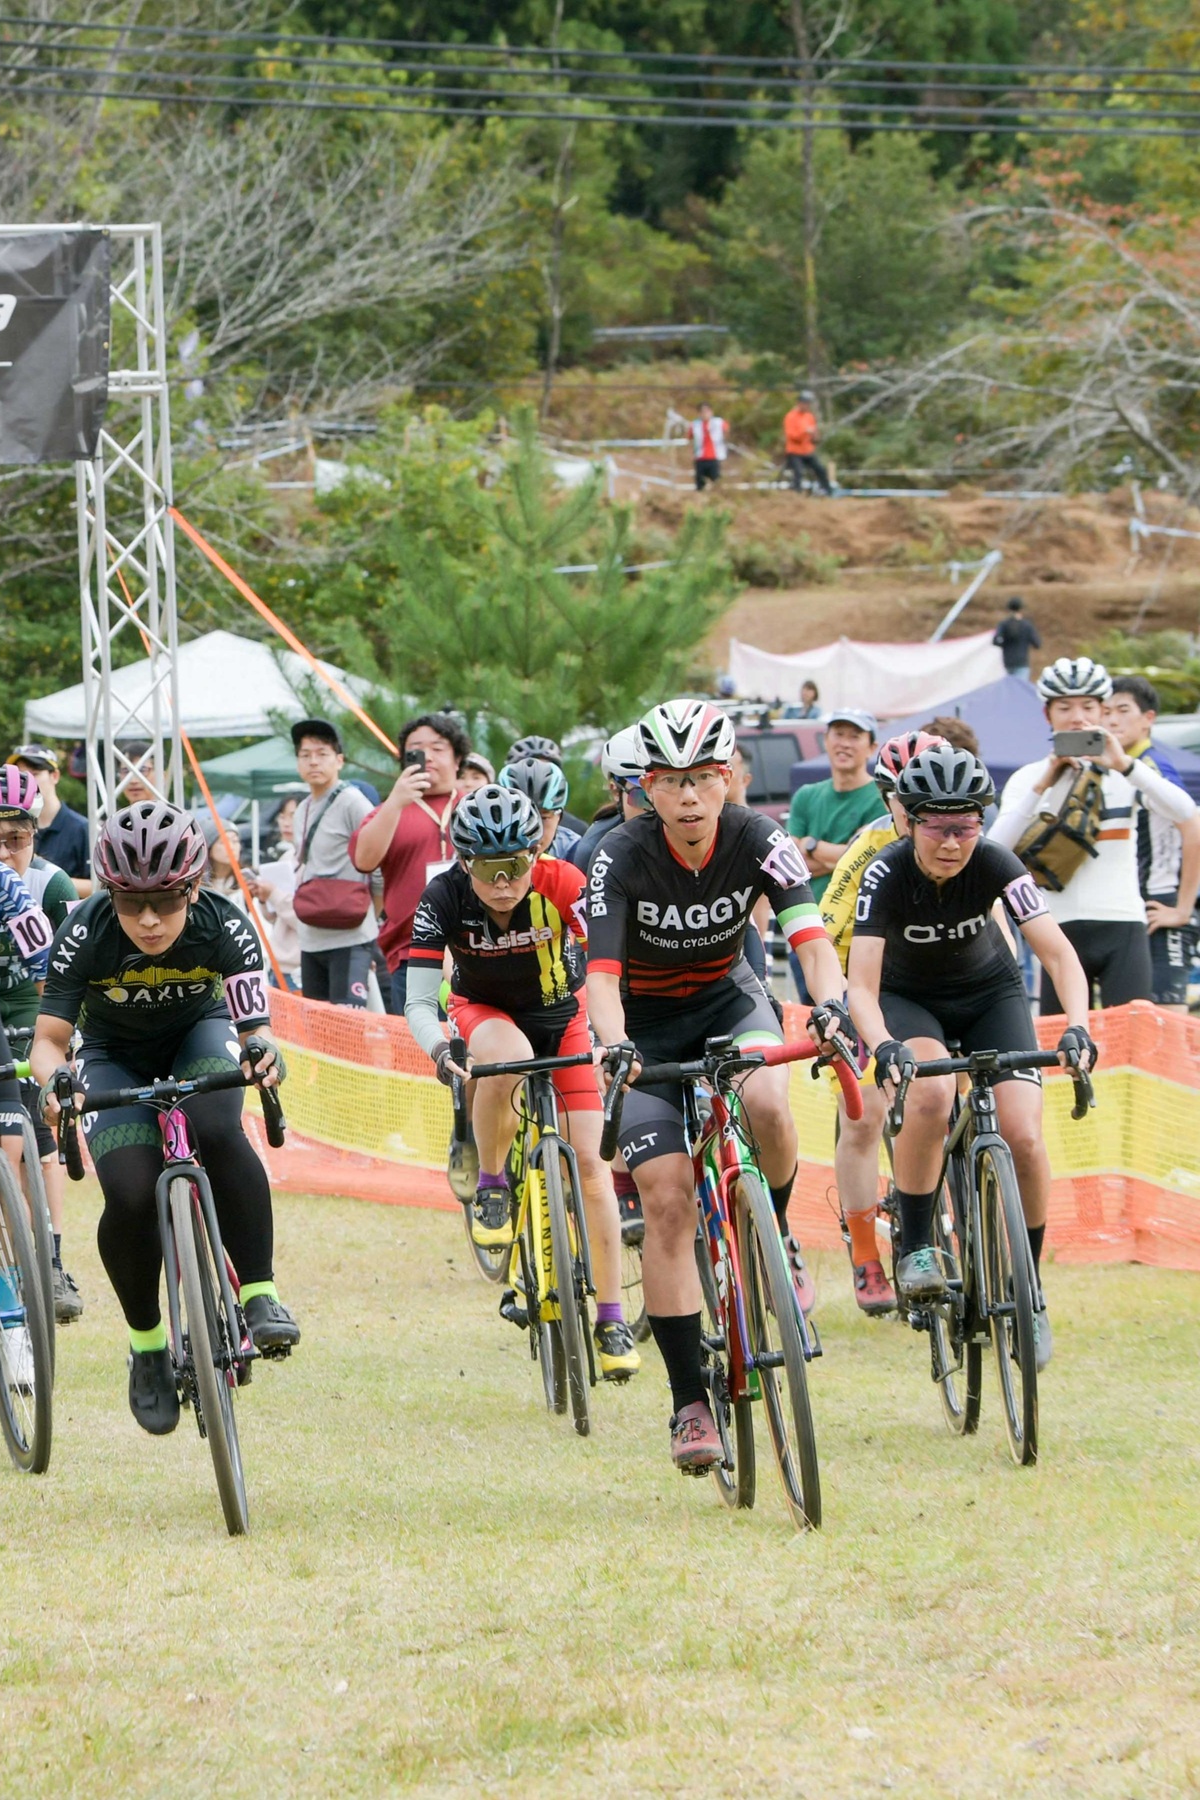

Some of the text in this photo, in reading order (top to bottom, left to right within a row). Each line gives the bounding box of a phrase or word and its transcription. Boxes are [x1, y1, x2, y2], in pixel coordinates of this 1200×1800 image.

[849, 845, 878, 874] RACING
[590, 849, 614, 918] BAGGY
[636, 885, 754, 931] BAGGY
[16, 911, 50, 953] 10
[51, 923, 89, 975] AXIS
[224, 918, 259, 966] AXIS
[639, 916, 747, 949] RACING CYCLOCROSS
[226, 977, 266, 1019] 103
